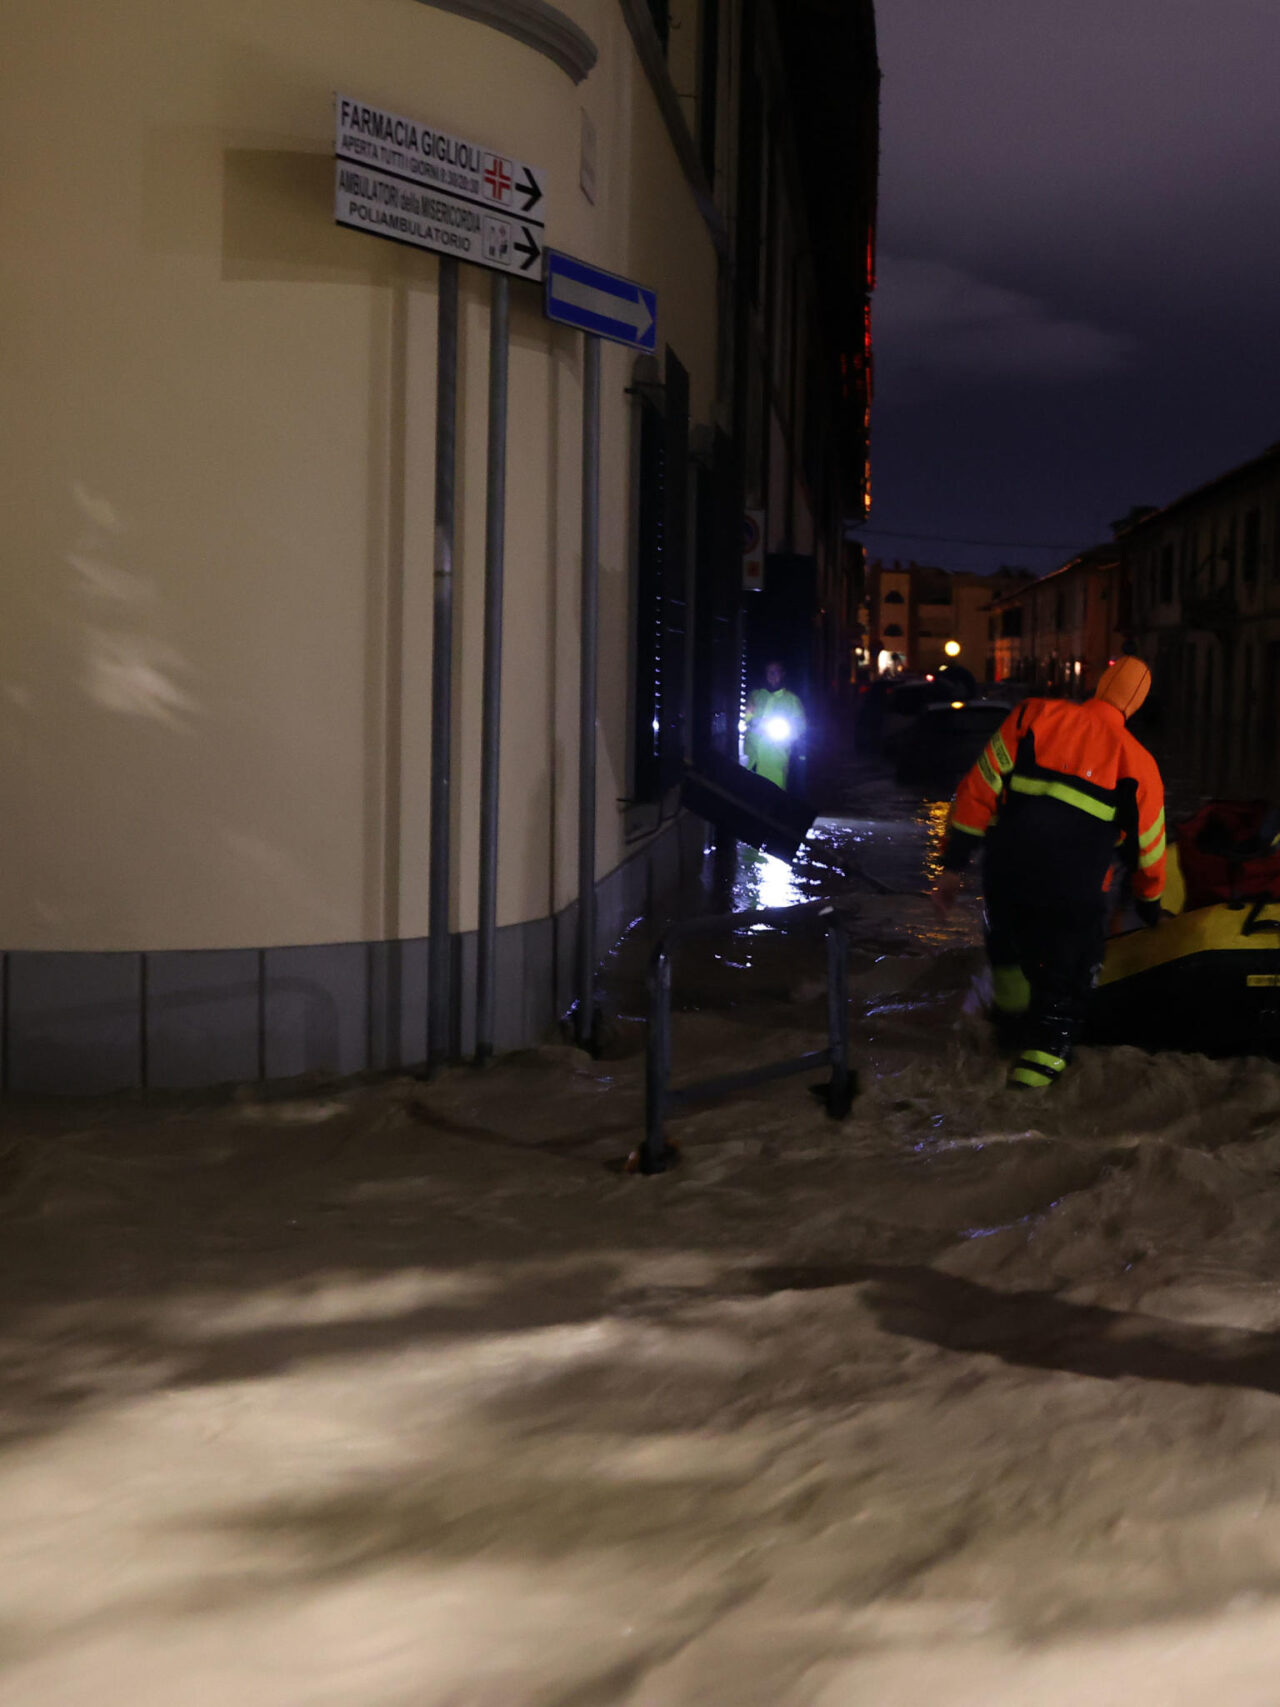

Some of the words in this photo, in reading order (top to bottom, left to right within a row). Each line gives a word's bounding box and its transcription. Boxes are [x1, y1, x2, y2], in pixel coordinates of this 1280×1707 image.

[341, 100, 419, 151] FARMACIA
[421, 130, 481, 174] GIGLIOLI
[342, 134, 378, 159] APERTA
[380, 146, 405, 168] TUTTI
[411, 158, 439, 181] GIORNI
[340, 170, 399, 208] AMBULATORI
[421, 196, 481, 233] MISERICORDIA
[349, 201, 471, 252] POLIAMBULATORIO
